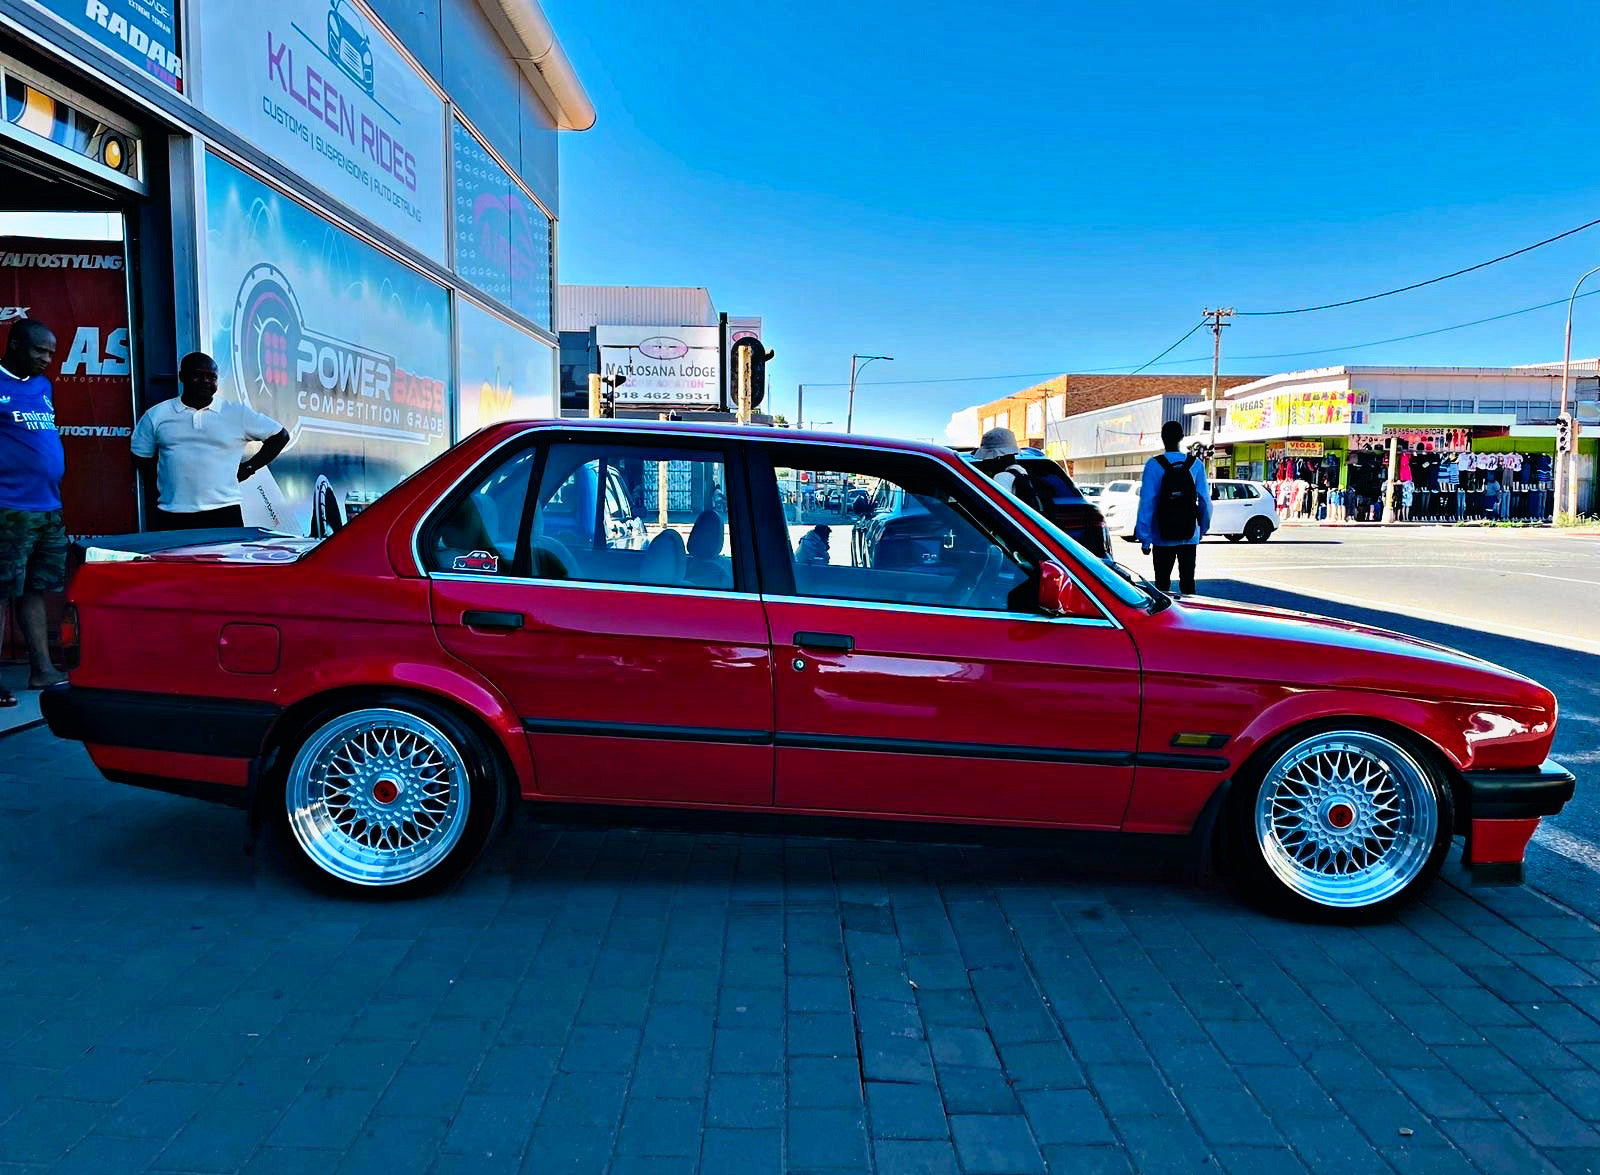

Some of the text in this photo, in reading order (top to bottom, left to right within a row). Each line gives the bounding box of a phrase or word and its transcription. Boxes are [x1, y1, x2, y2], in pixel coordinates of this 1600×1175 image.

[85, 0, 182, 79] RADAR
[267, 31, 416, 192] KLEEN RIDES
[263, 96, 309, 142] CUSTOMS
[315, 135, 369, 188] SUSPENSIONS
[0, 307, 30, 320] EX
[297, 340, 392, 401] POWER
[606, 362, 716, 377] MATLOSANA LODGE
[644, 392, 670, 400] 462
[298, 391, 443, 432] COMPETITION GRADE
[1240, 399, 1264, 411] VEGAS
[12, 411, 55, 422] Emirate
[55, 426, 131, 437] UTOSTYLING
